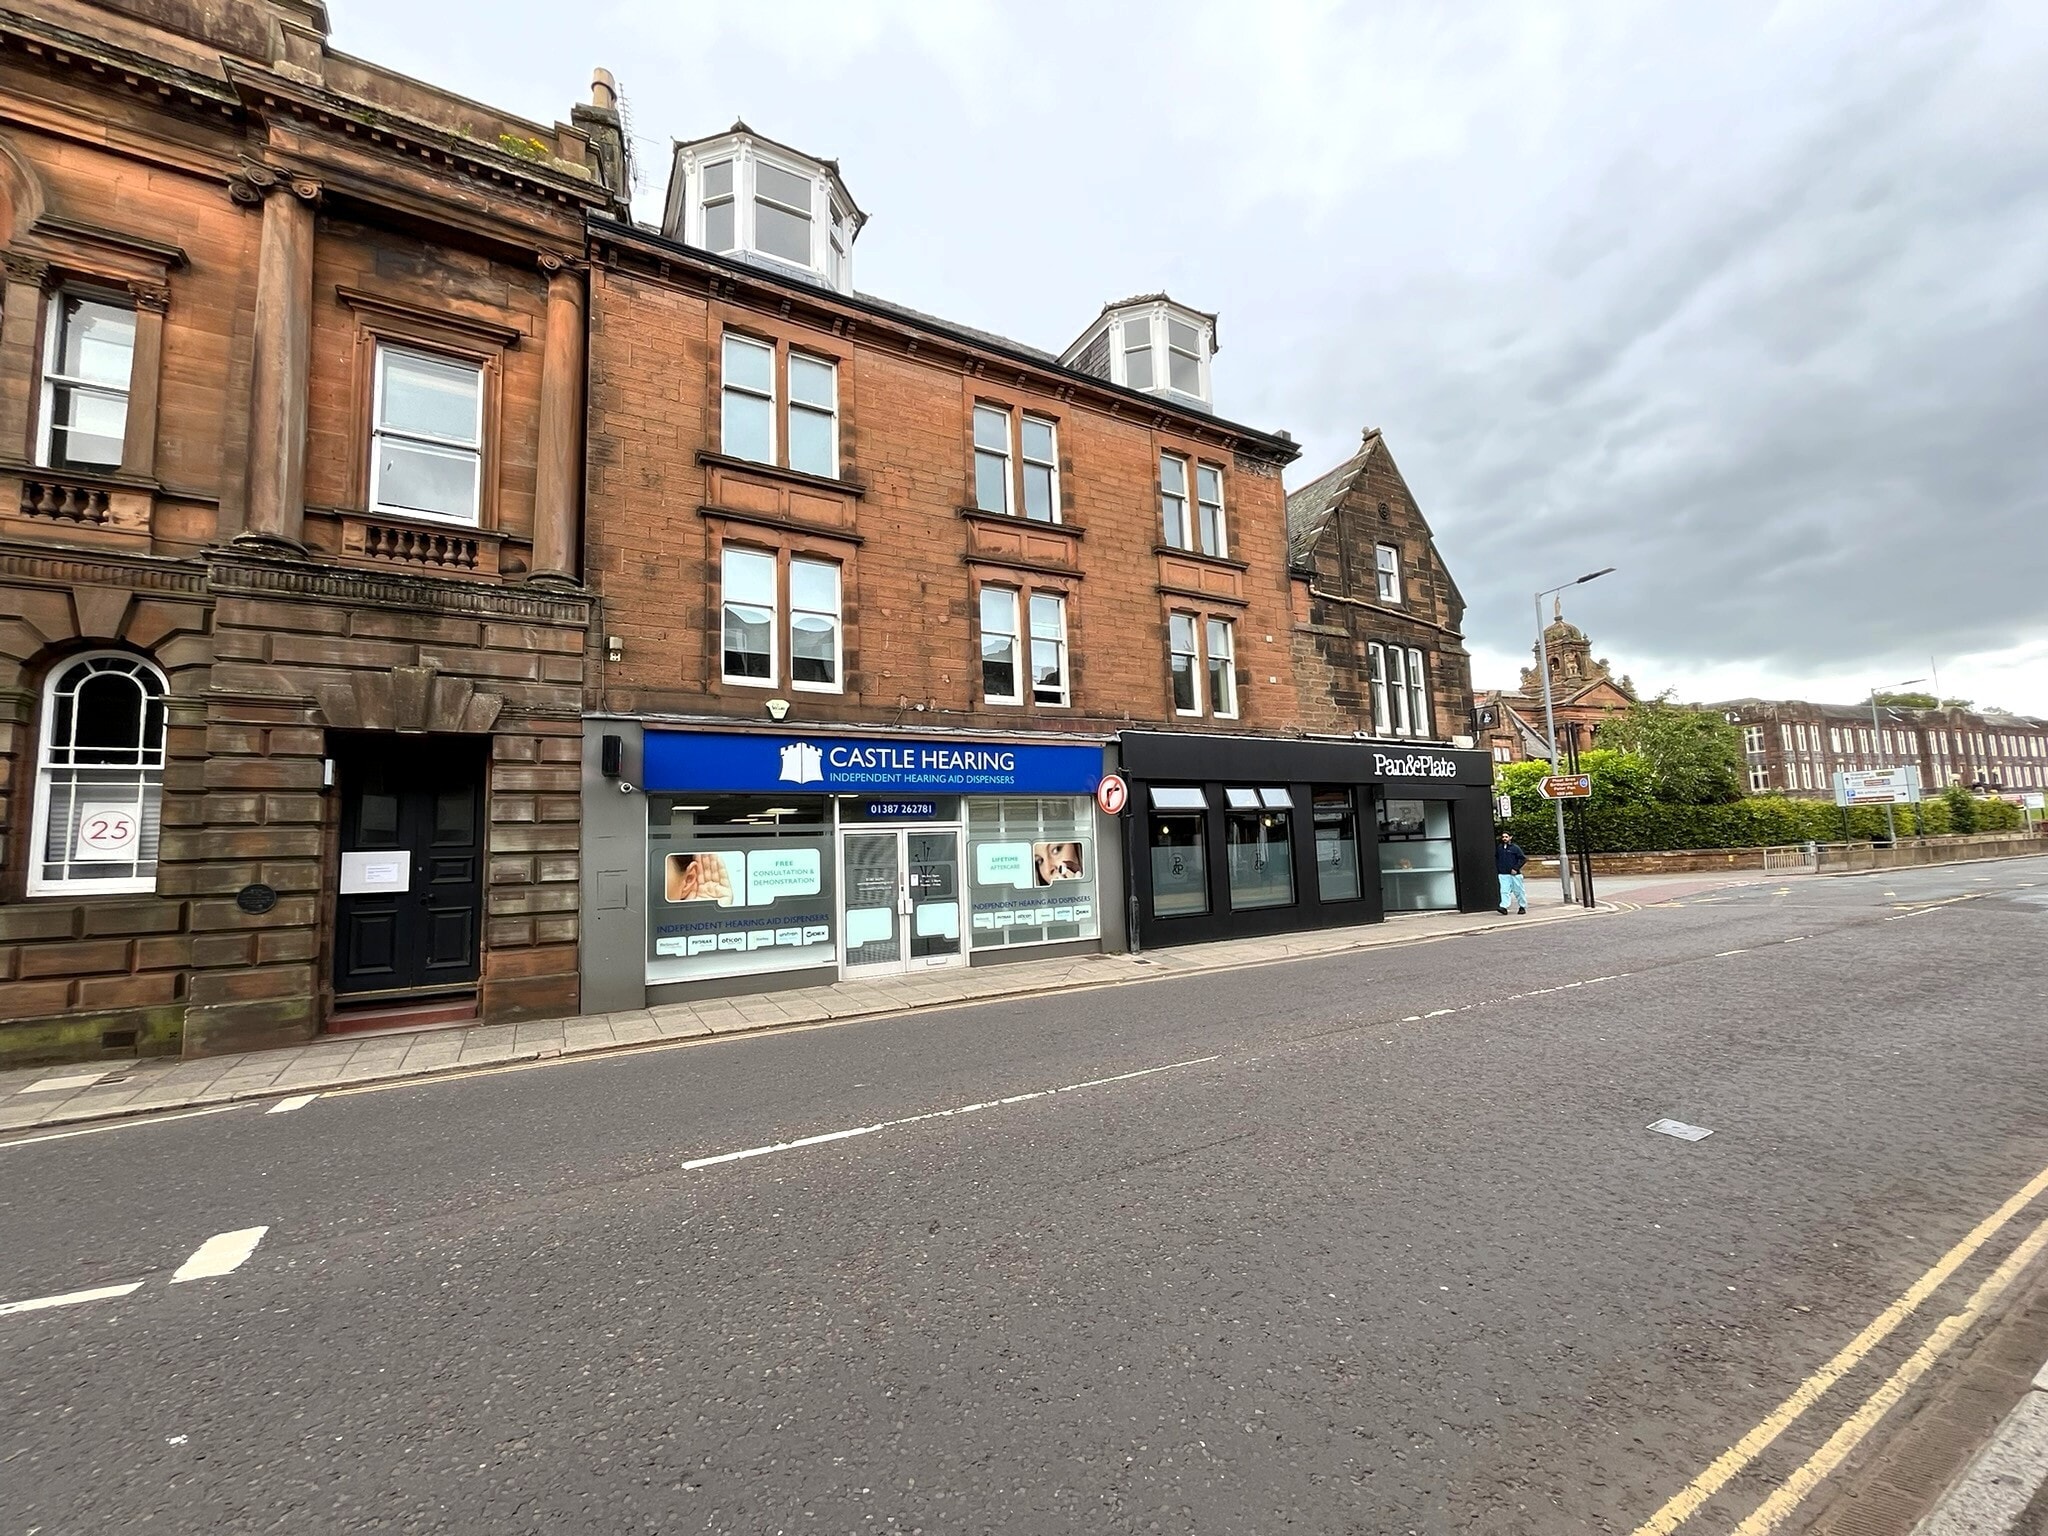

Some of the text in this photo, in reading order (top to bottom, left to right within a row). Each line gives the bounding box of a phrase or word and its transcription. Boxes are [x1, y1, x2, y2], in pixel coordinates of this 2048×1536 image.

[829, 746, 1015, 771] CASTLE HEARING
[1372, 753, 1457, 777] Pan&Plate
[830, 772, 1015, 785] INDEPENDENT HEARING AID DISPENSERS
[870, 804, 932, 814] 01387 262781
[90, 820, 129, 840] 25
[753, 868, 808, 877] CONSULTATION
[753, 877, 815, 886] DEMONSTRATION
[973, 901, 1017, 910] INDEPENDENT
[1019, 899, 1046, 907] HEARING
[1058, 896, 1091, 904] DISPENSERS
[656, 913, 829, 934] INDEPENDENT HEARING AID DISPENSERS
